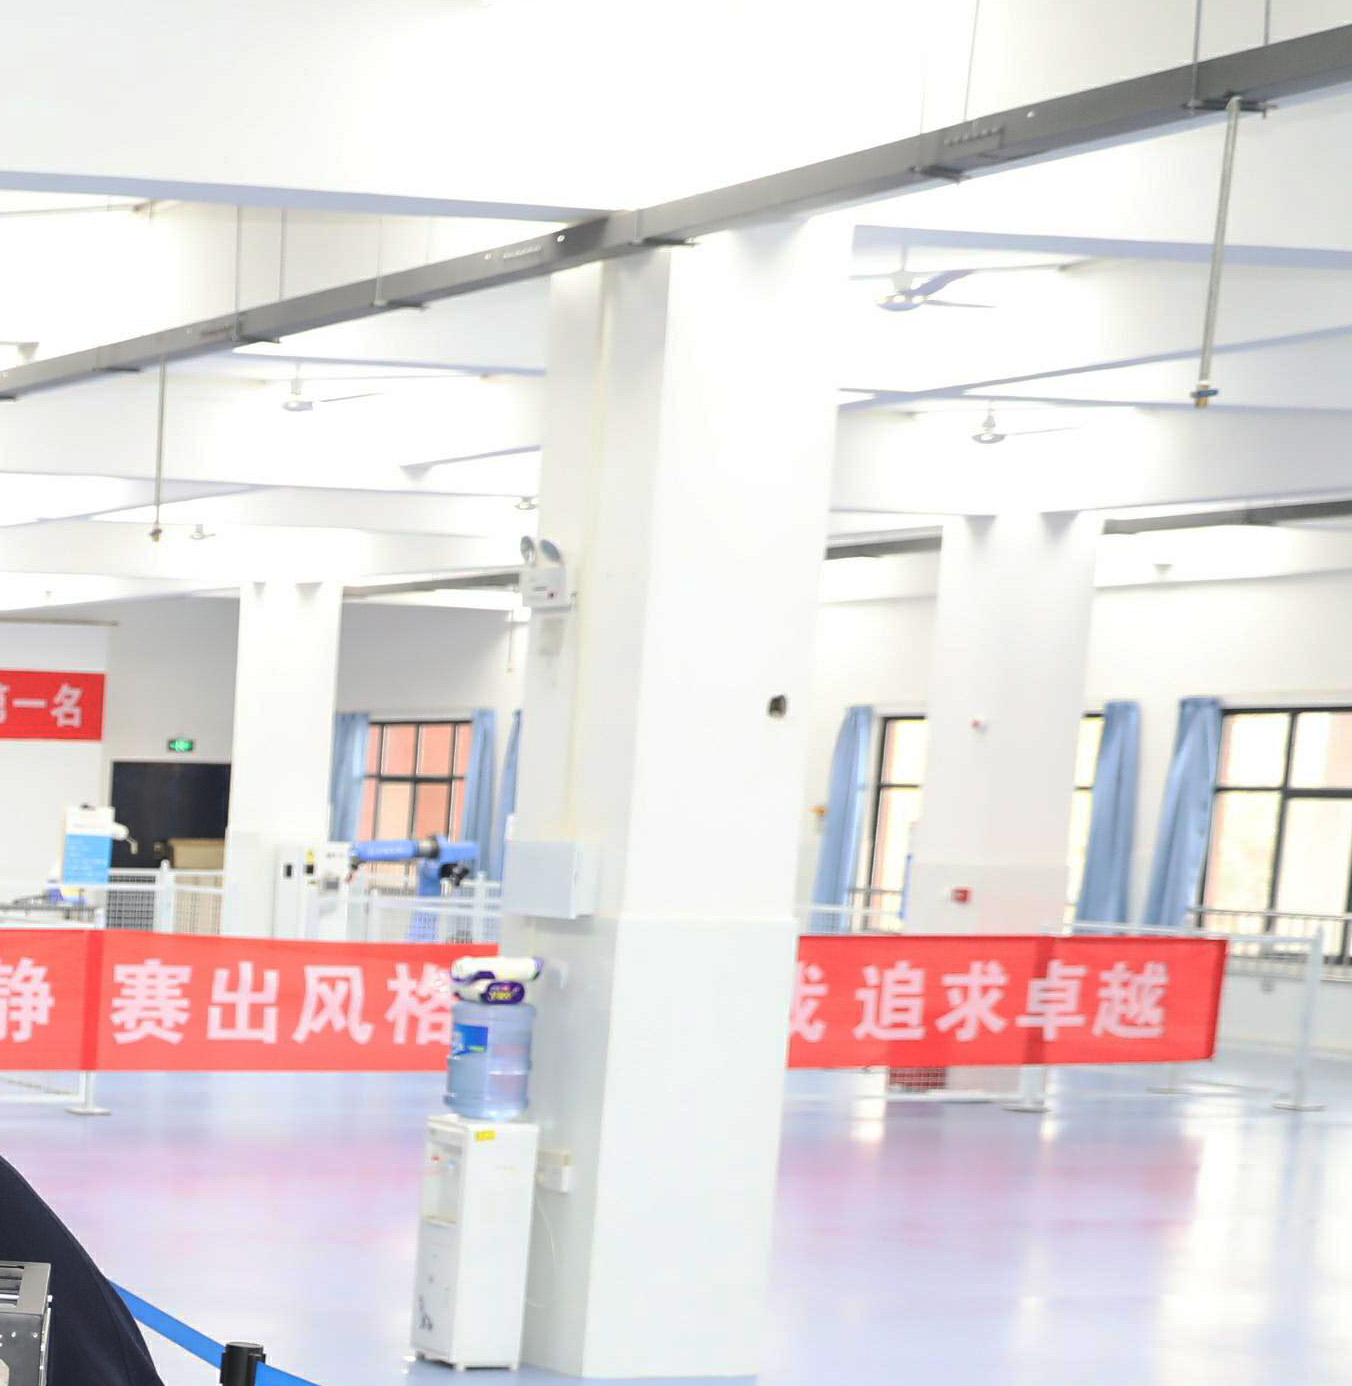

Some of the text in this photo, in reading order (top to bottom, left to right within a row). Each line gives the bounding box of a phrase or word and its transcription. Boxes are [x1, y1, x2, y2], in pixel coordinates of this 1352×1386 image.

[111, 958, 452, 1046] 赛出风格
[852, 959, 1169, 1042] 追求卓越
